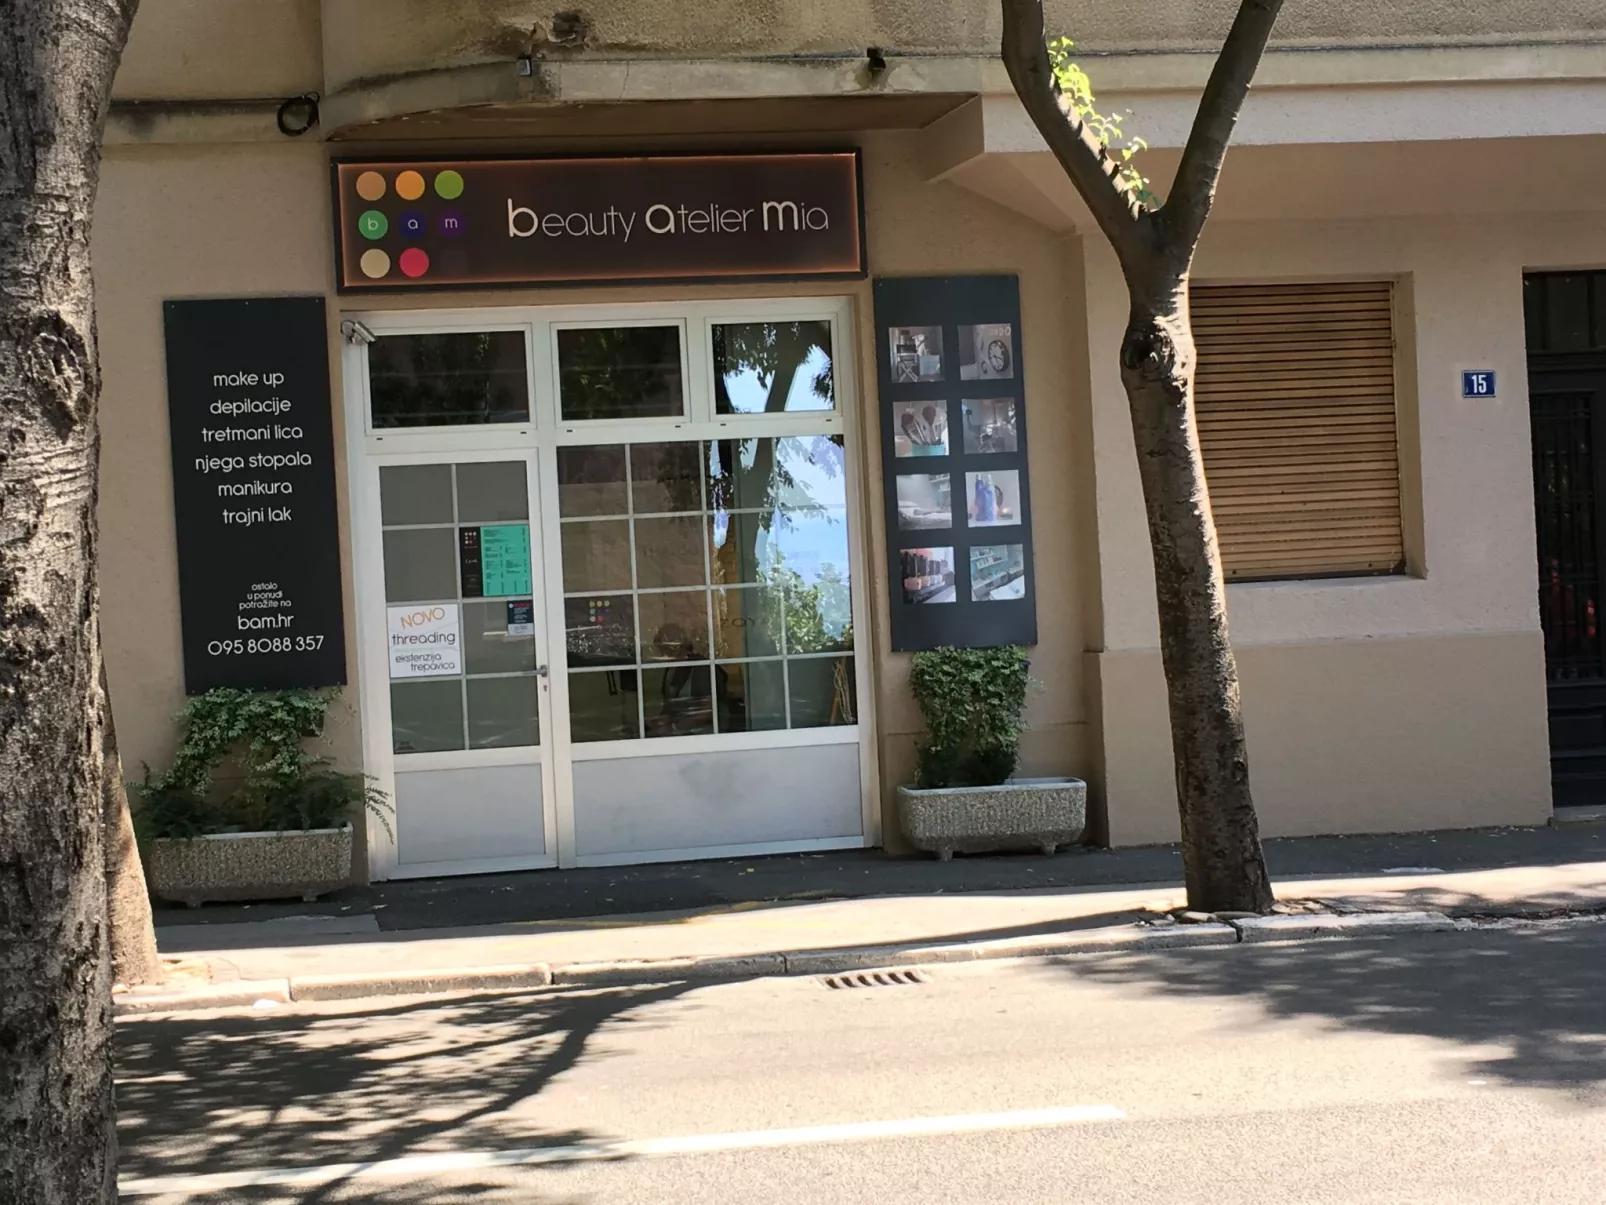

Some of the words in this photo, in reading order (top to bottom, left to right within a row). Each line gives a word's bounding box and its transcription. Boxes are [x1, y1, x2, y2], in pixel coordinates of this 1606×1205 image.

[507, 198, 636, 242] beauty
[645, 201, 755, 234] atelier
[762, 200, 829, 232] mia
[213, 371, 259, 387] make
[262, 372, 285, 389] up
[1471, 374, 1487, 394] 15
[209, 397, 292, 418] depilacije
[201, 424, 271, 443] tretmani
[274, 424, 303, 440] lica
[195, 454, 245, 474] njega
[248, 451, 312, 470] stopala
[217, 480, 292, 497] manikura
[222, 507, 265, 527] trajni
[267, 506, 292, 522] lak
[247, 592, 254, 601] u
[254, 589, 283, 602] ponudi
[250, 581, 279, 591] ostalo
[280, 597, 292, 607] na
[237, 612, 295, 631] bam.hr
[400, 606, 446, 630] NOVO
[207, 639, 244, 656] 095
[247, 637, 292, 654] 8088
[295, 634, 325, 652] 357
[391, 632, 456, 646] threading
[395, 652, 442, 664] ekstenzija
